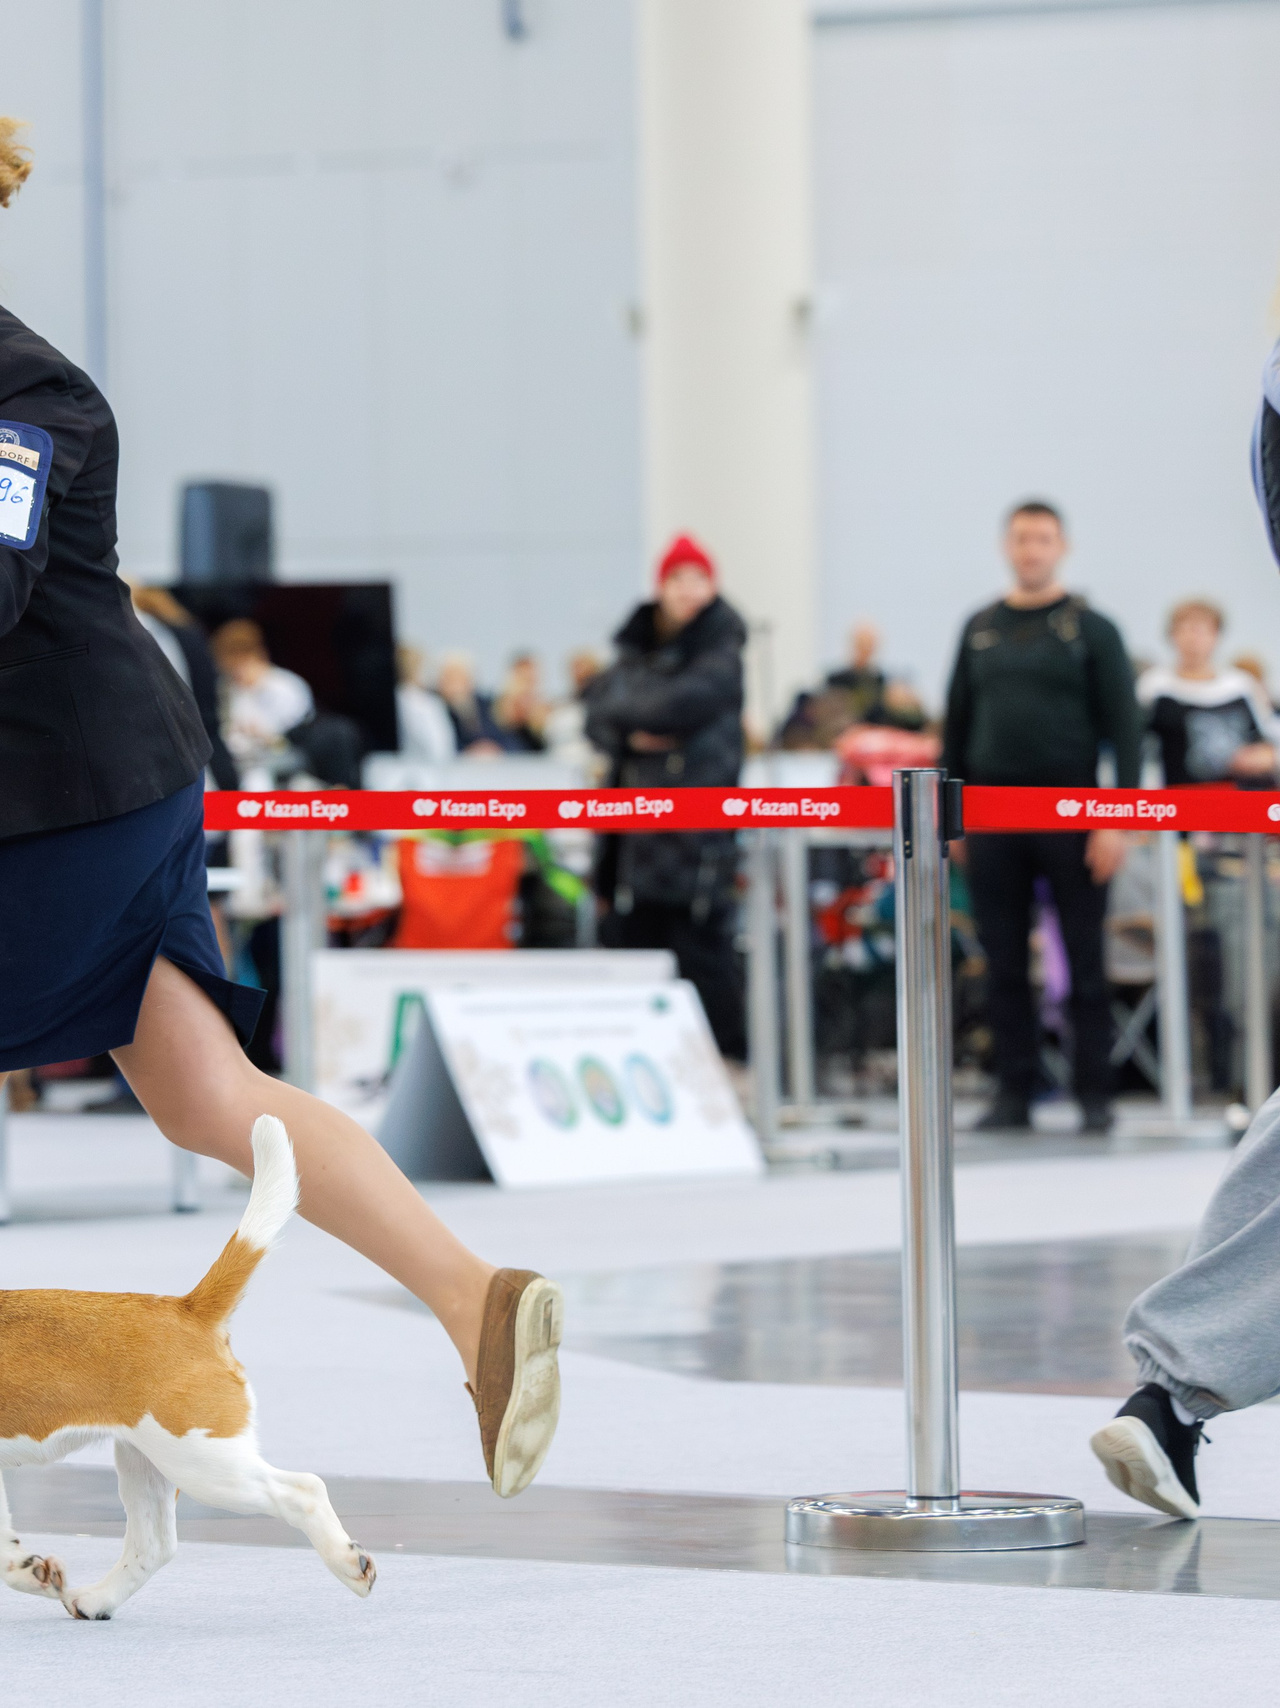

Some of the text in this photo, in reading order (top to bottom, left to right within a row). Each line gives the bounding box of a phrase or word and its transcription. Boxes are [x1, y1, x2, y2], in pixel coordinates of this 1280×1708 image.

[264, 800, 349, 821] Kazan Expo
[440, 799, 526, 821] Kazan Expo
[586, 796, 674, 819] Kazan Expo
[751, 798, 840, 821] Kazan Expo
[1085, 799, 1177, 823] Kazan Expo
